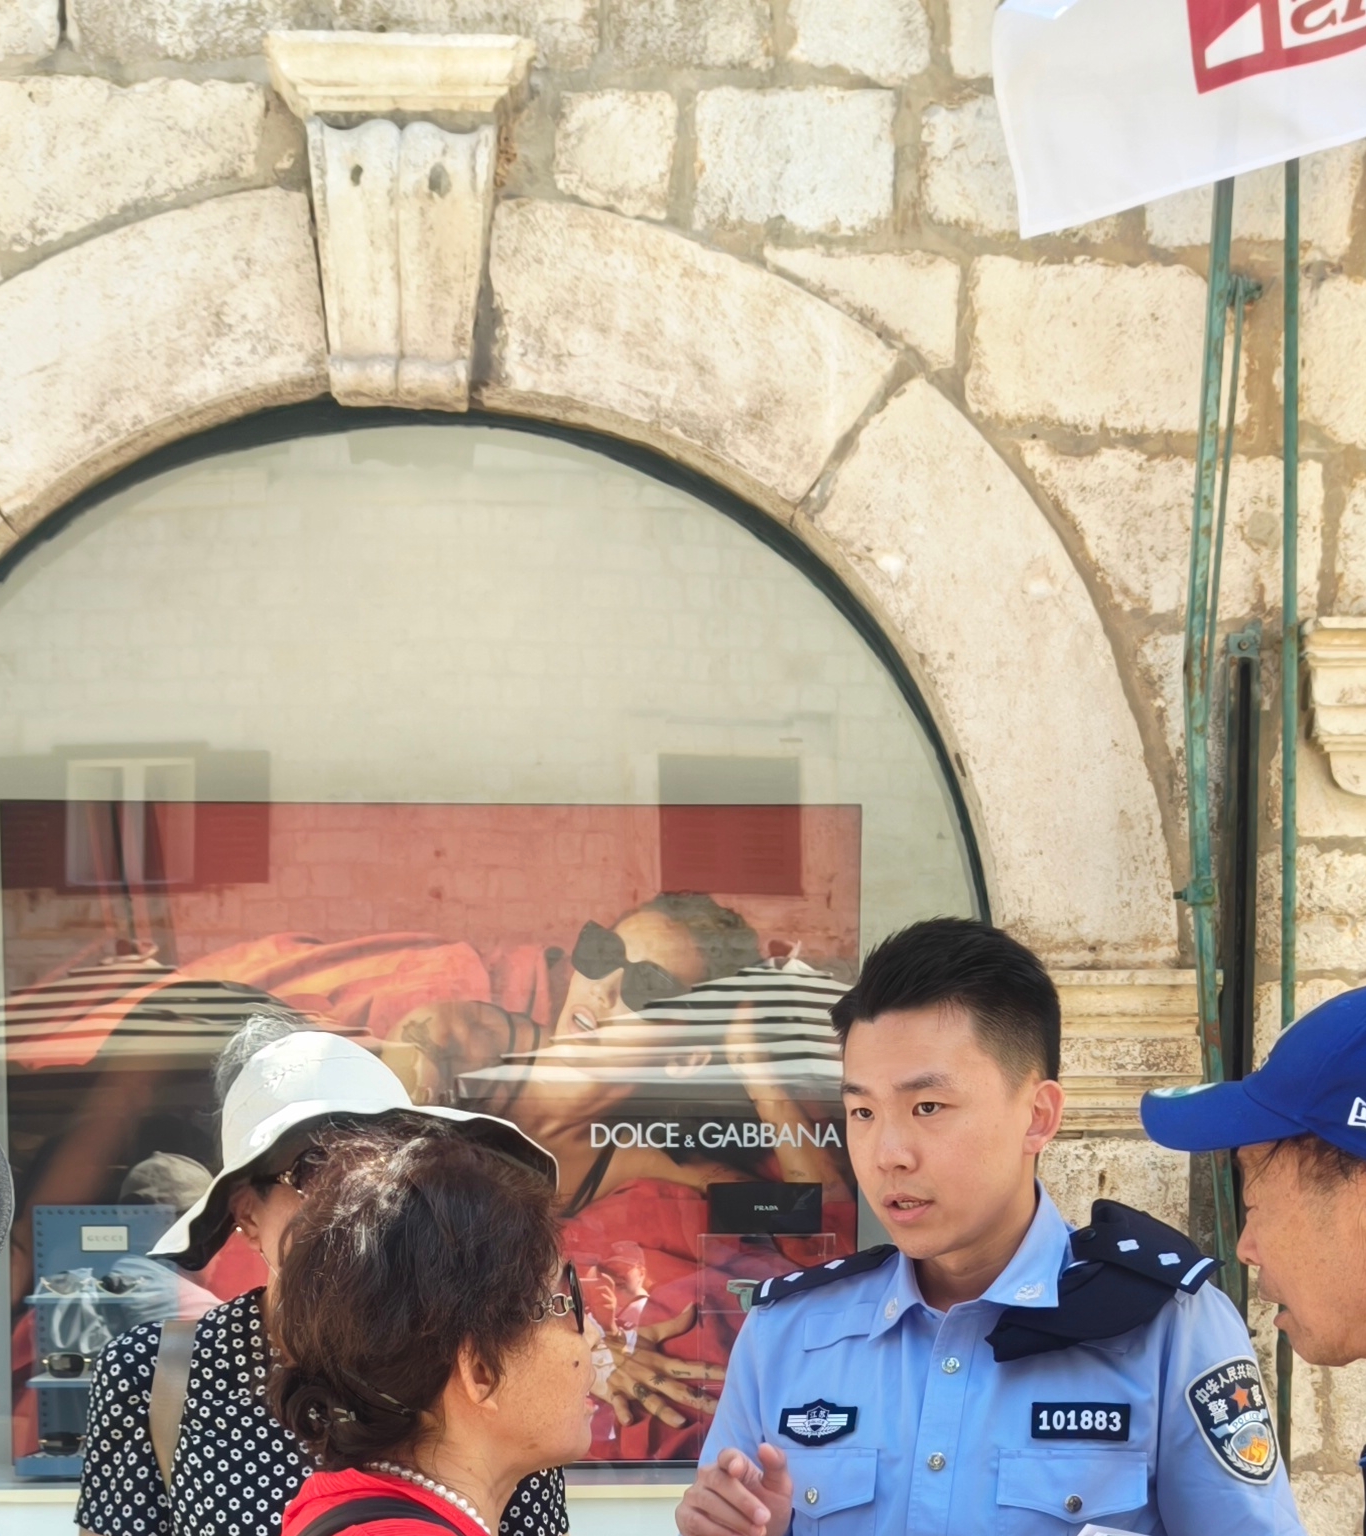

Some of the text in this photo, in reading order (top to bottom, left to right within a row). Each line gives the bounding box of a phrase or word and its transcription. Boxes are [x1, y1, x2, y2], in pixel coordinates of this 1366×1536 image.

[590, 1122, 842, 1149] DOLCE & GABBANA
[1195, 1363, 1260, 1404] 中华人民共和
[1039, 1409, 1122, 1432] 101883
